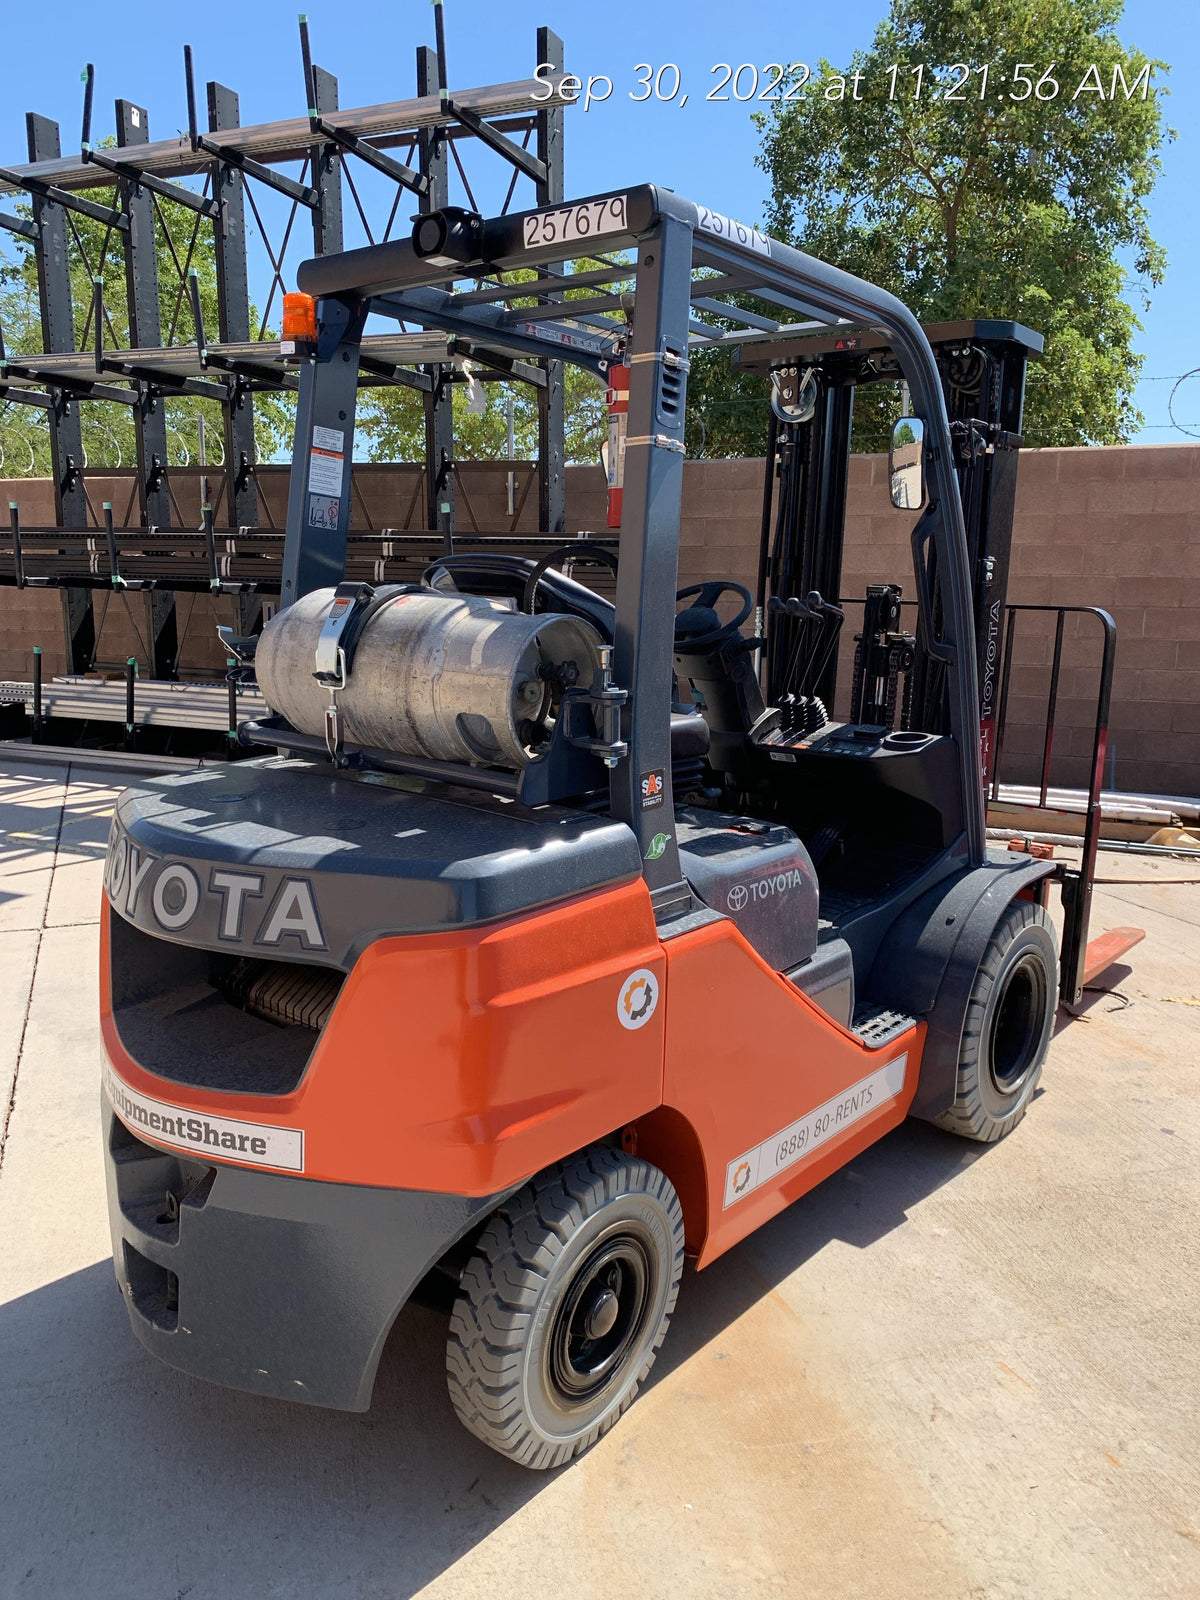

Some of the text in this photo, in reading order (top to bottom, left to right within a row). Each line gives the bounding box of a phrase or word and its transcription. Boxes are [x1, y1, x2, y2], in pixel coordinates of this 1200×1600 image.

[526, 197, 626, 246] 257679
[981, 599, 1001, 721] TOYOTA
[641, 774, 663, 796] SAS
[750, 869, 802, 902] TOYOTA
[774, 1084, 874, 1166] (888) 80-RENTS
